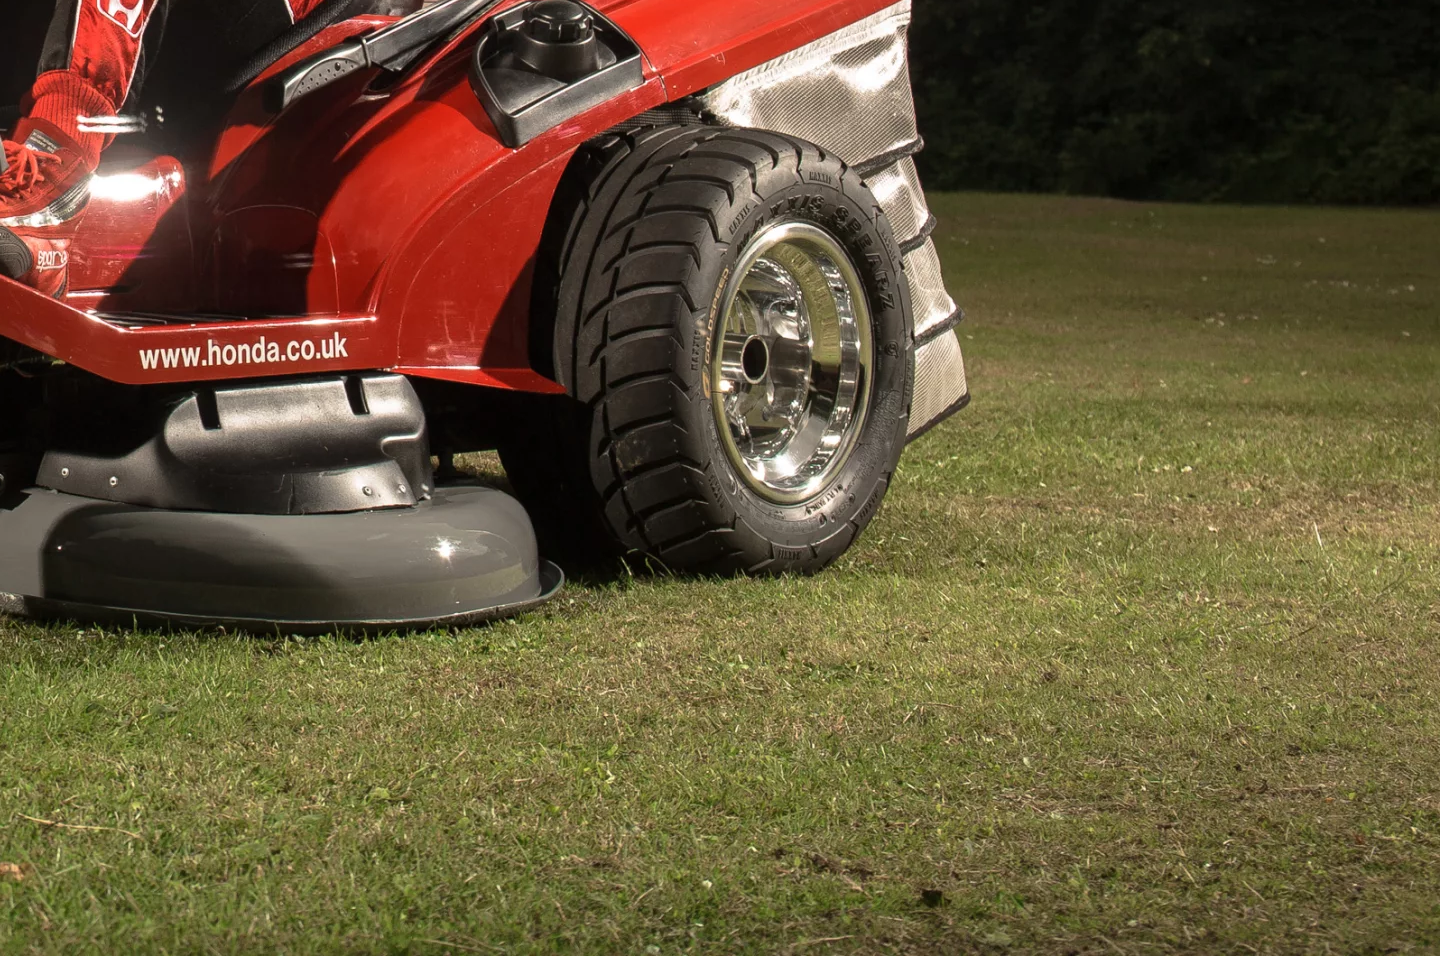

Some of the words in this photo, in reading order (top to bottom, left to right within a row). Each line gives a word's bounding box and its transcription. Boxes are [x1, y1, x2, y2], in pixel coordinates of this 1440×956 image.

[833, 204, 896, 311] SPEARZ
[139, 332, 348, 371] www.honda.co.uk
[704, 267, 730, 365] GOLDSPEED
